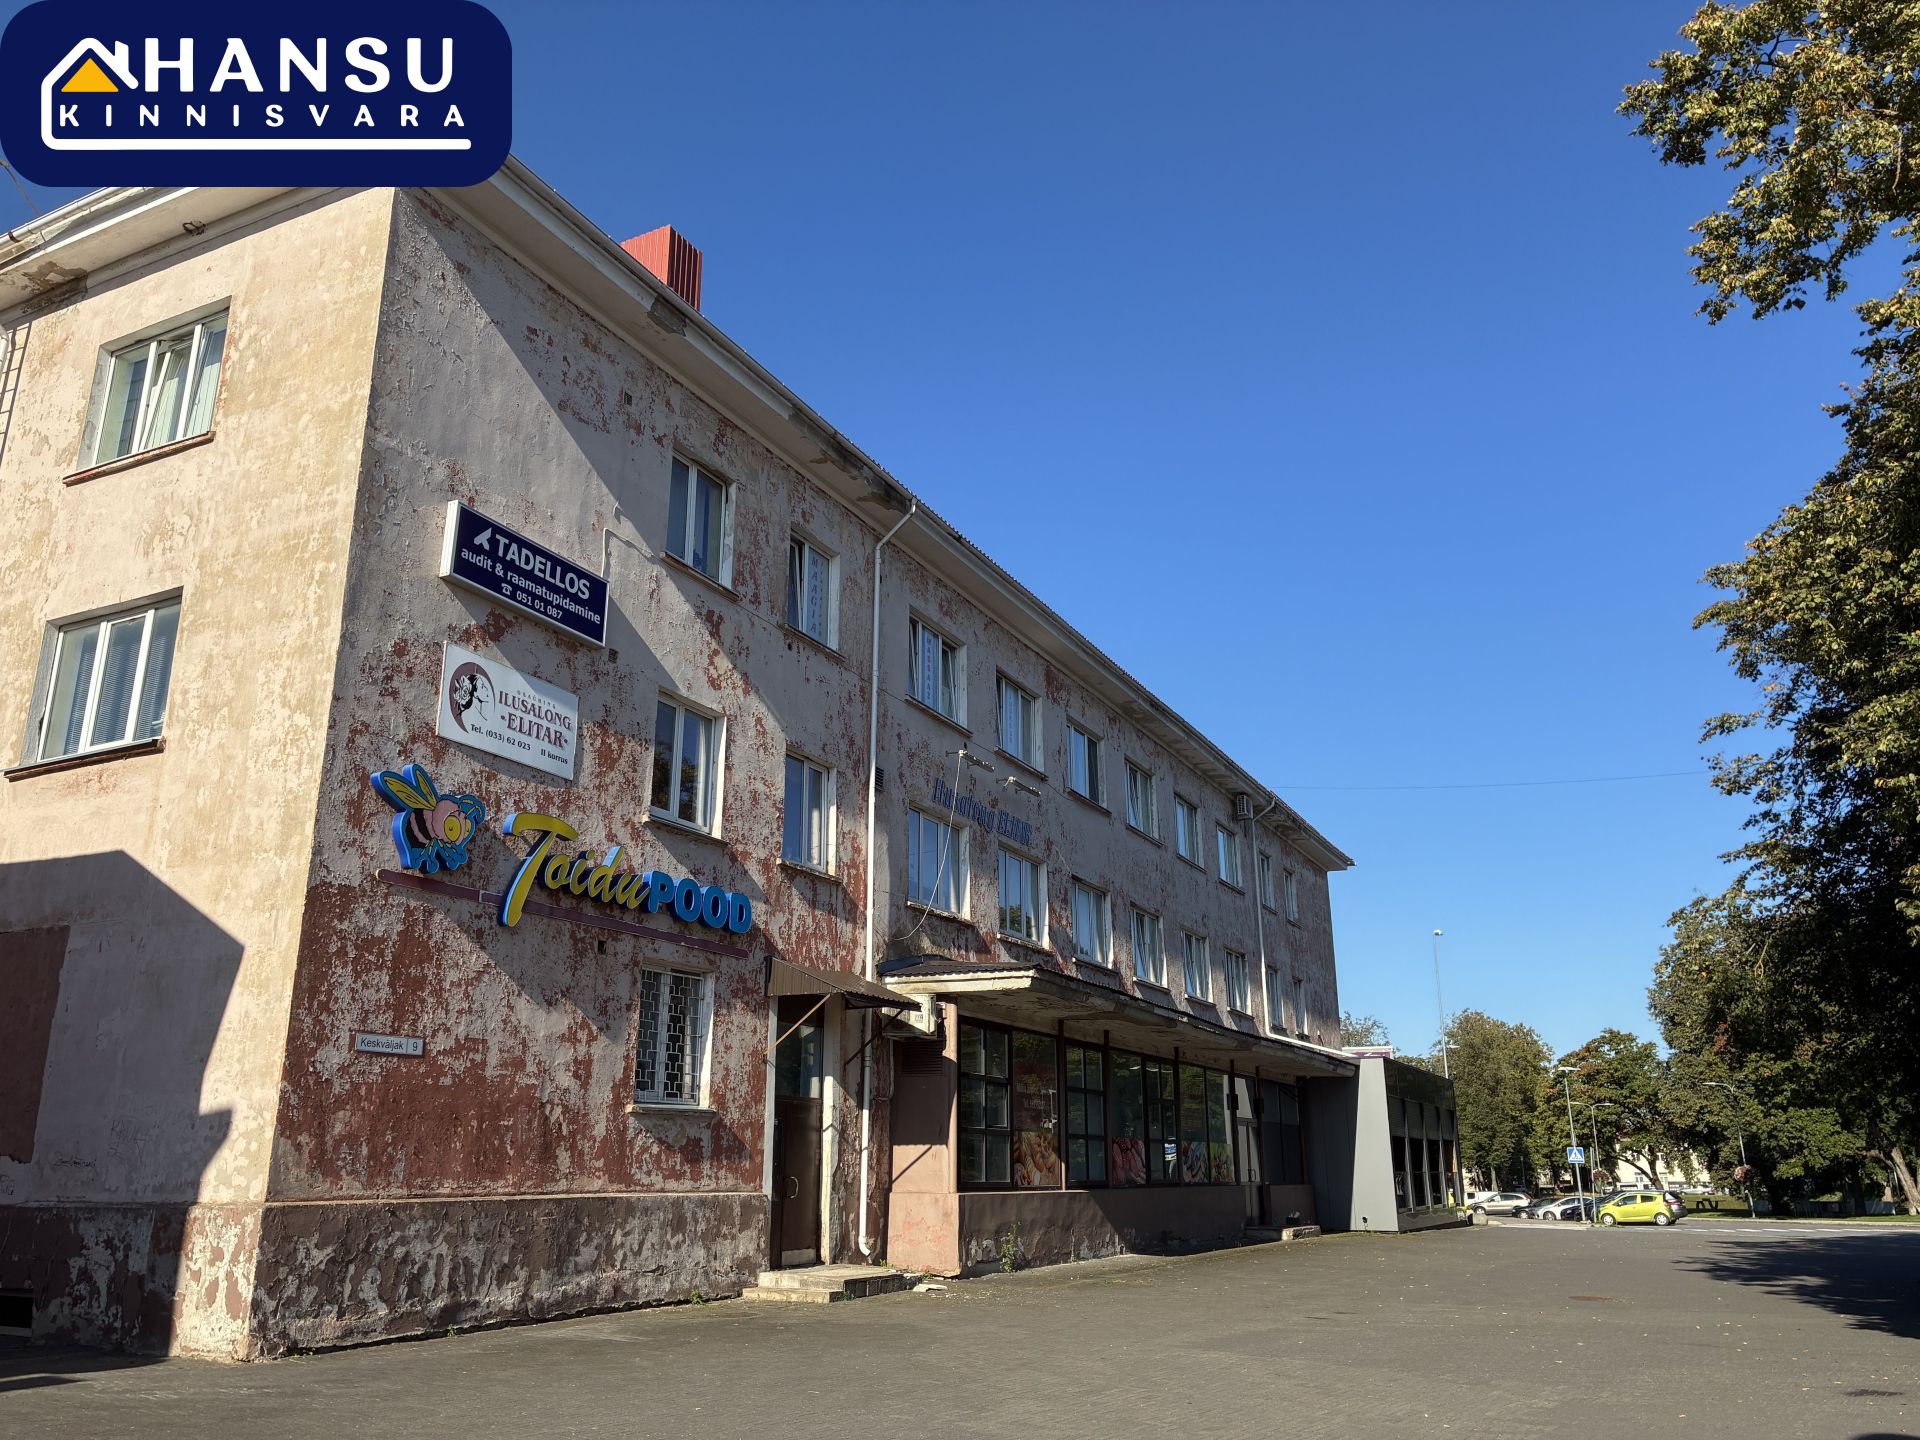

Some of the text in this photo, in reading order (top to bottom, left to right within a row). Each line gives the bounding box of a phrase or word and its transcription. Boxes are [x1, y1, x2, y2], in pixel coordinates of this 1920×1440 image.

[495, 533, 590, 600] TADELLOS
[461, 547, 601, 625] audit & raamatupidamine
[516, 590, 563, 620] 051 01 087
[499, 690, 572, 731] ILUSALONG
[470, 723, 483, 735] Tel.
[485, 728, 505, 744] (033)
[506, 736, 516, 746] 62
[517, 739, 531, 751] 023
[360, 1036, 418, 1052] Keskväljak 9
